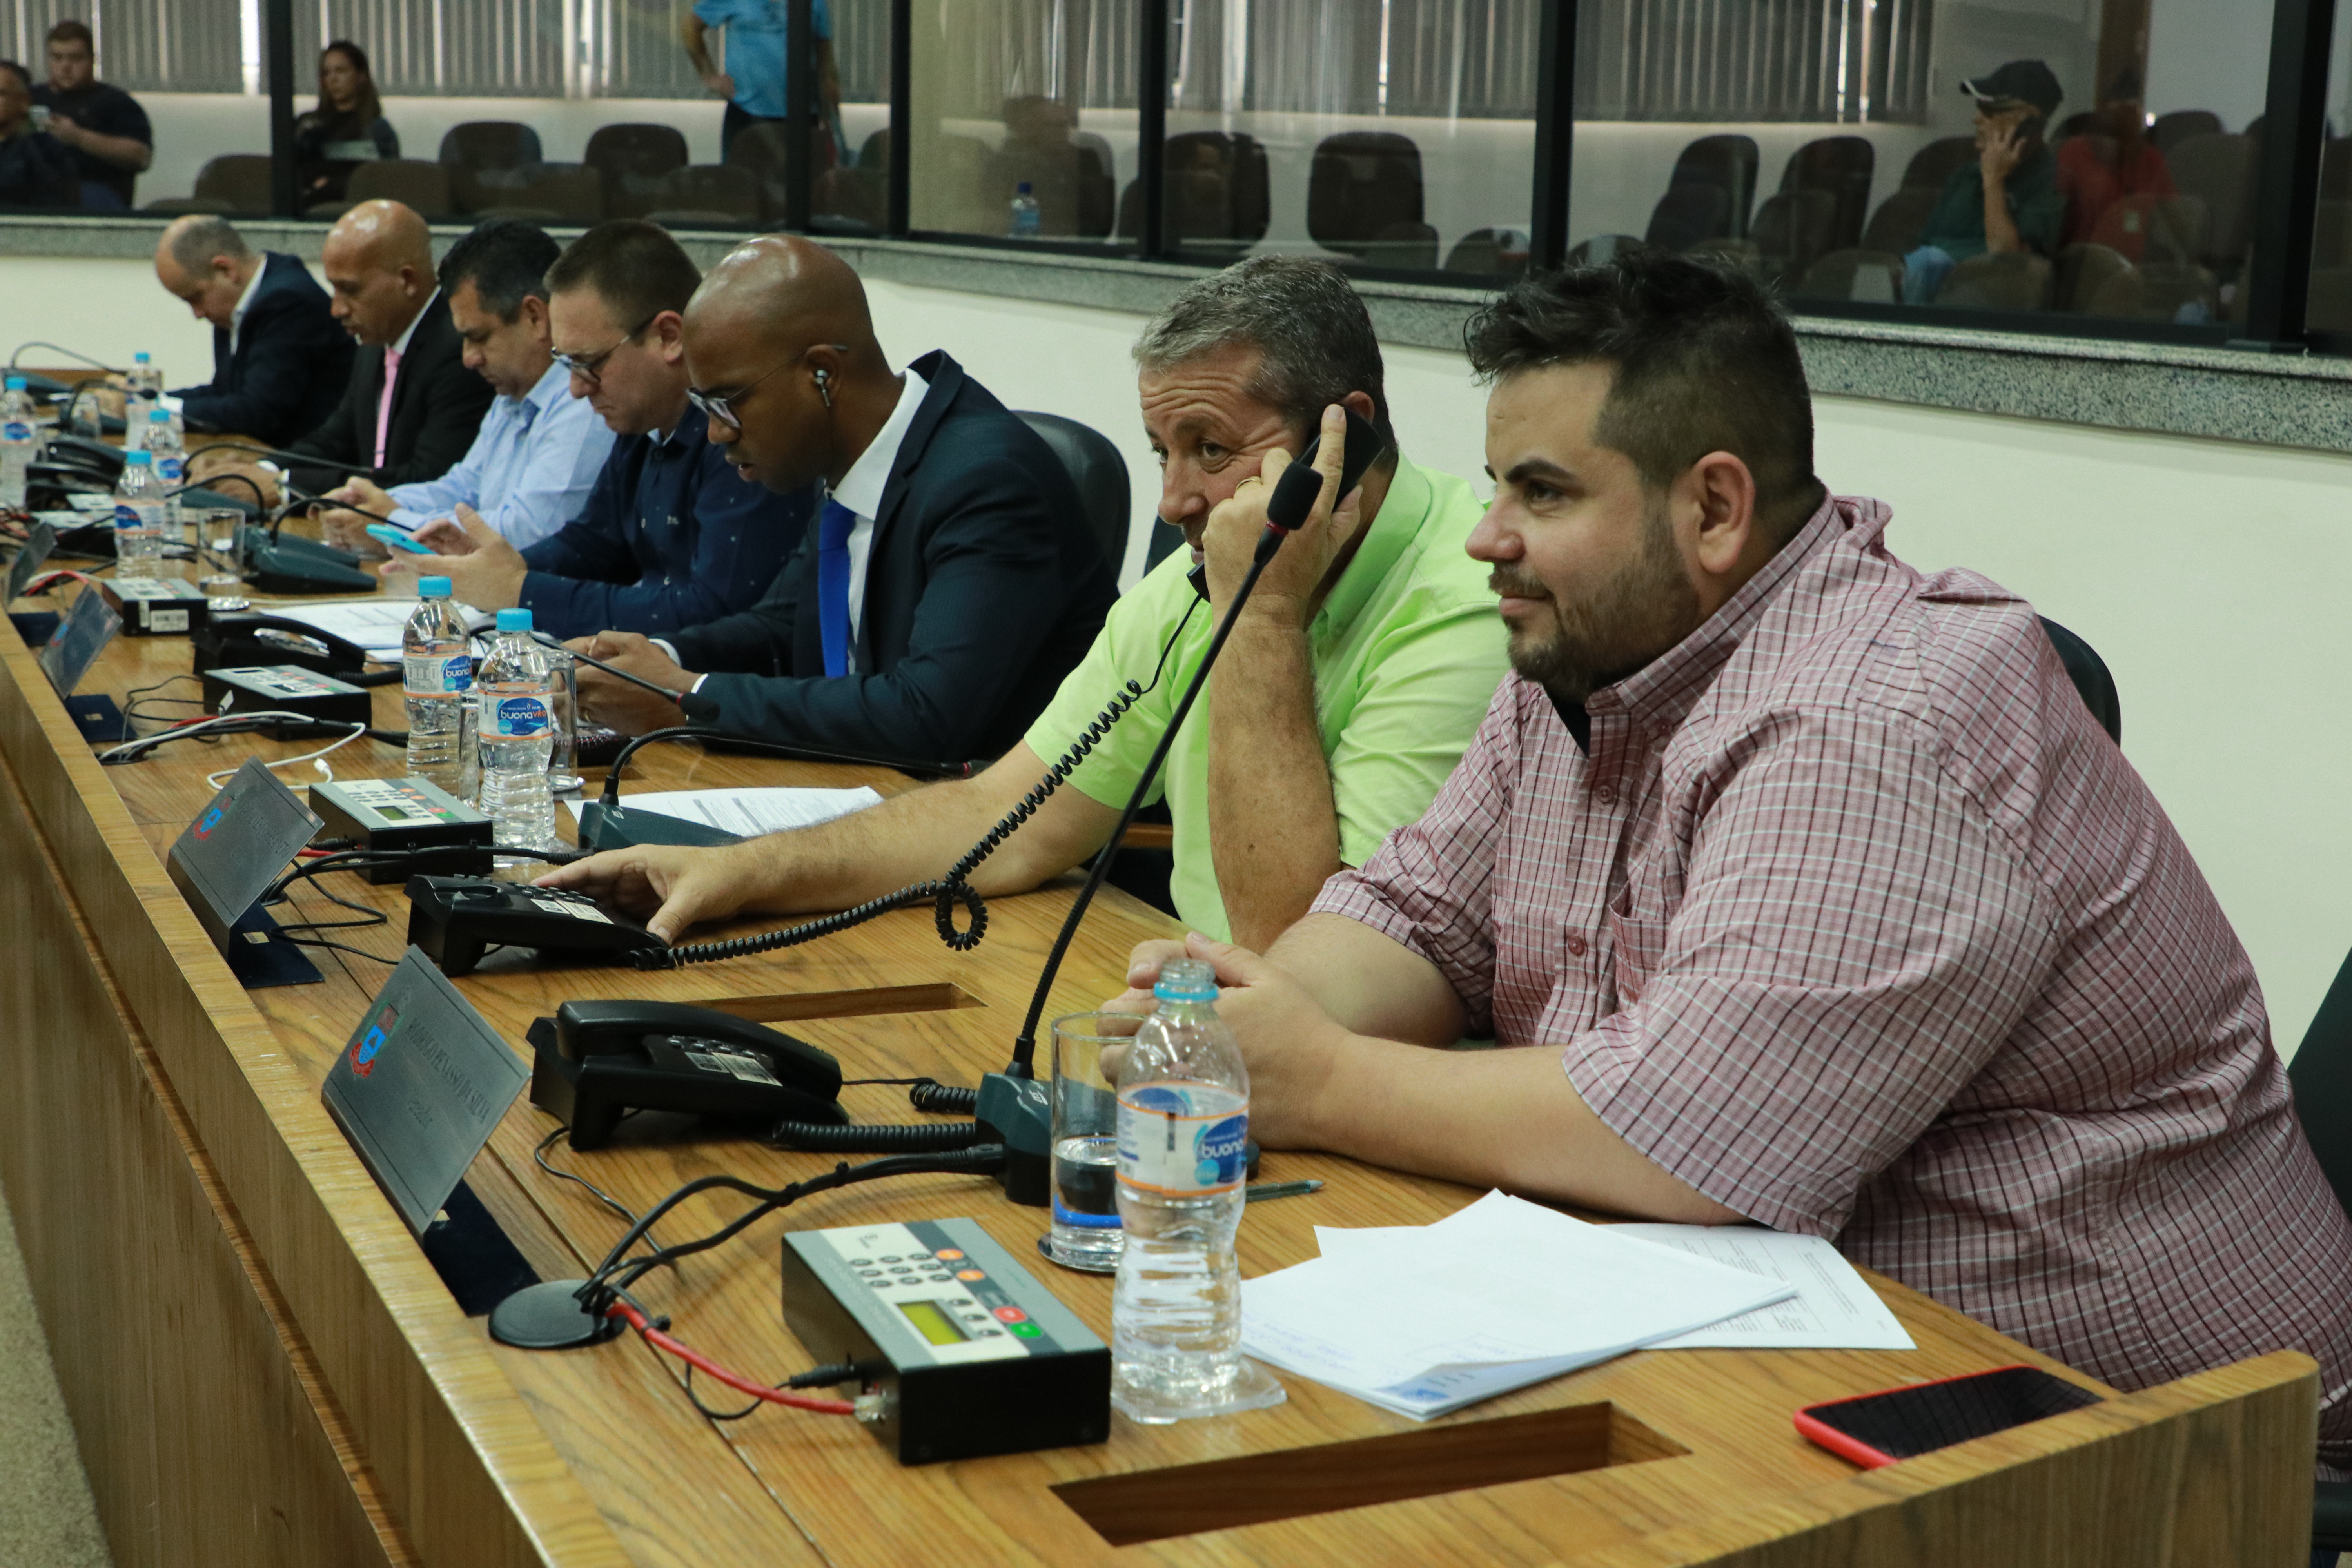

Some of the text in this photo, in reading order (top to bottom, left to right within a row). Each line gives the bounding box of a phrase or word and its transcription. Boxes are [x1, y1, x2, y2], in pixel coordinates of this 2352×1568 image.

[500, 710, 546, 719] buonavita
[405, 1018, 439, 1061] RODRIGO
[457, 1079, 474, 1104] DA
[466, 1089, 491, 1124] SILVA
